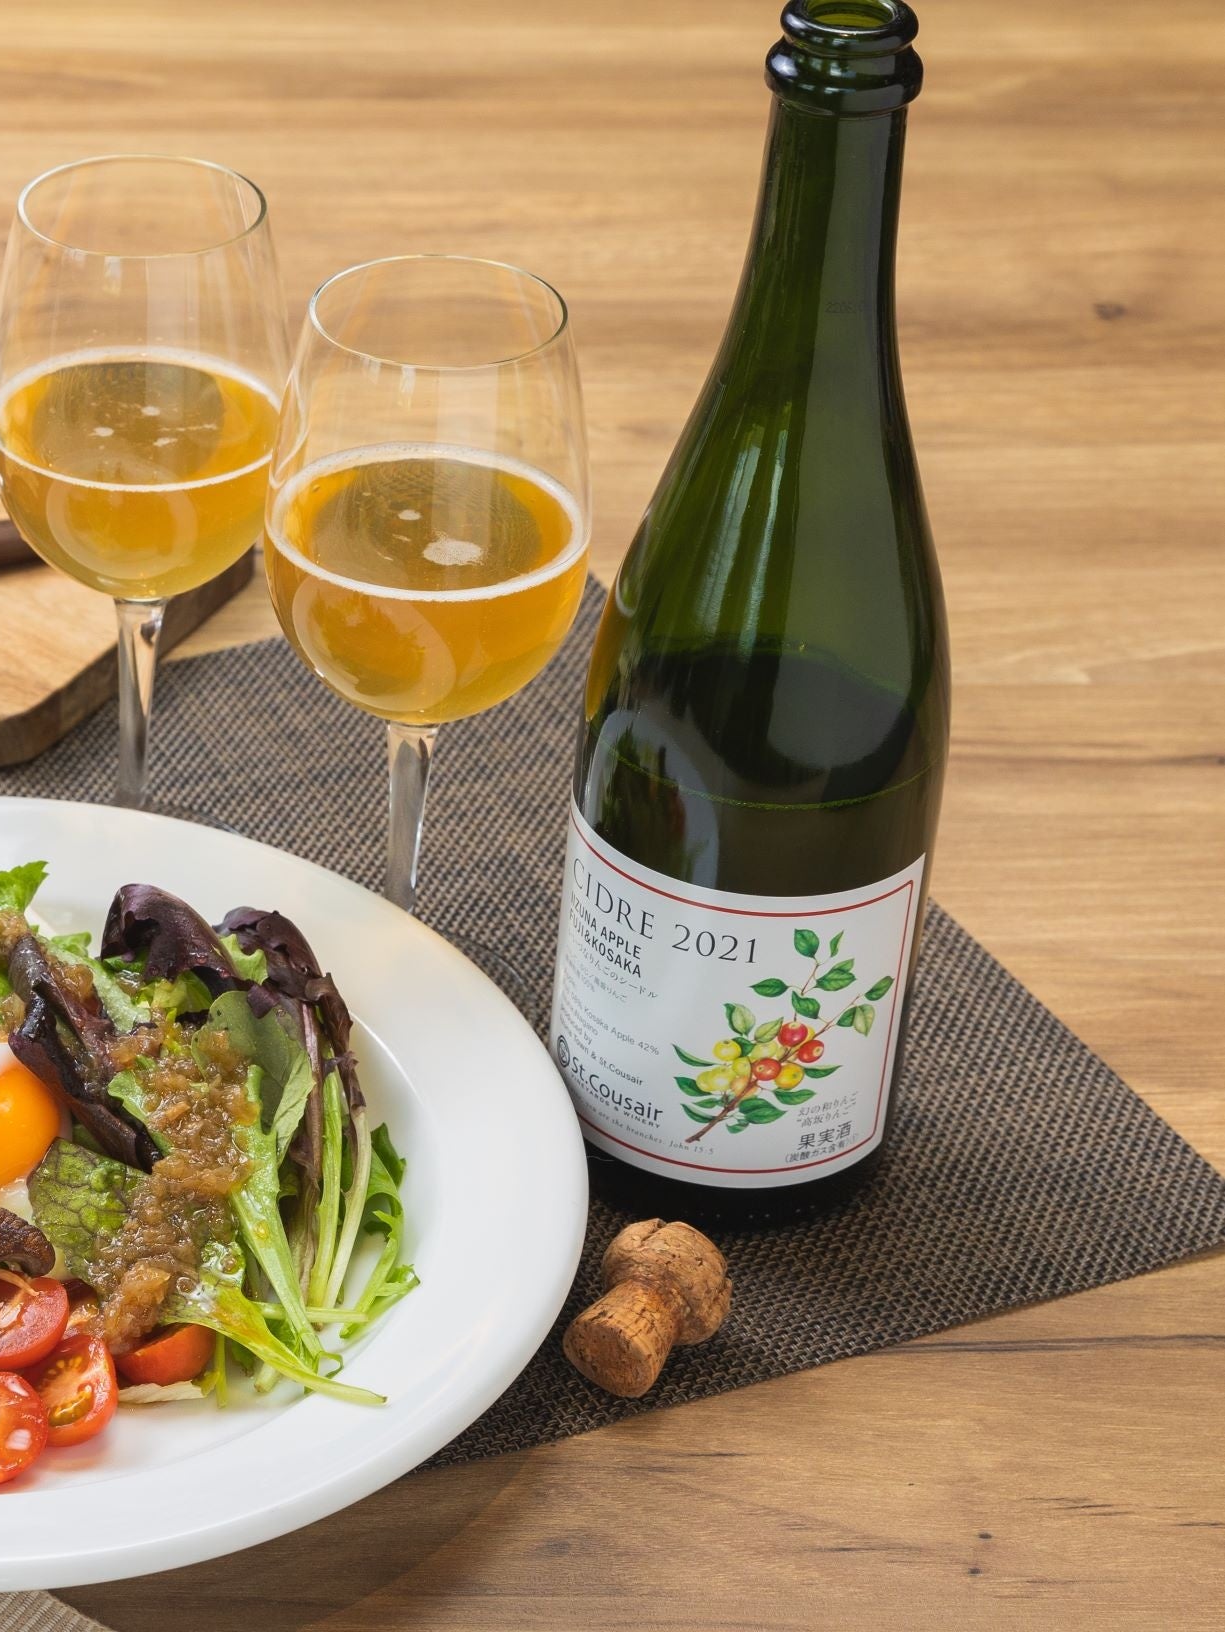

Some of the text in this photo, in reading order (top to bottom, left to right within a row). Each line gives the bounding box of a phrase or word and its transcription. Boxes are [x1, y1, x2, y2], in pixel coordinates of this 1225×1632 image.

[573, 858, 757, 963] CIDRE 2021
[569, 908, 642, 978] FUJI&KOSAKA
[601, 926, 642, 960] APPLE
[610, 1027, 635, 1046] Apple
[638, 1040, 660, 1056] 42%
[599, 1057, 644, 1086] St.Cousair
[571, 1056, 663, 1121] St.Cousair
[623, 1110, 661, 1129] WINERY
[797, 1120, 853, 1151] 果実酒
